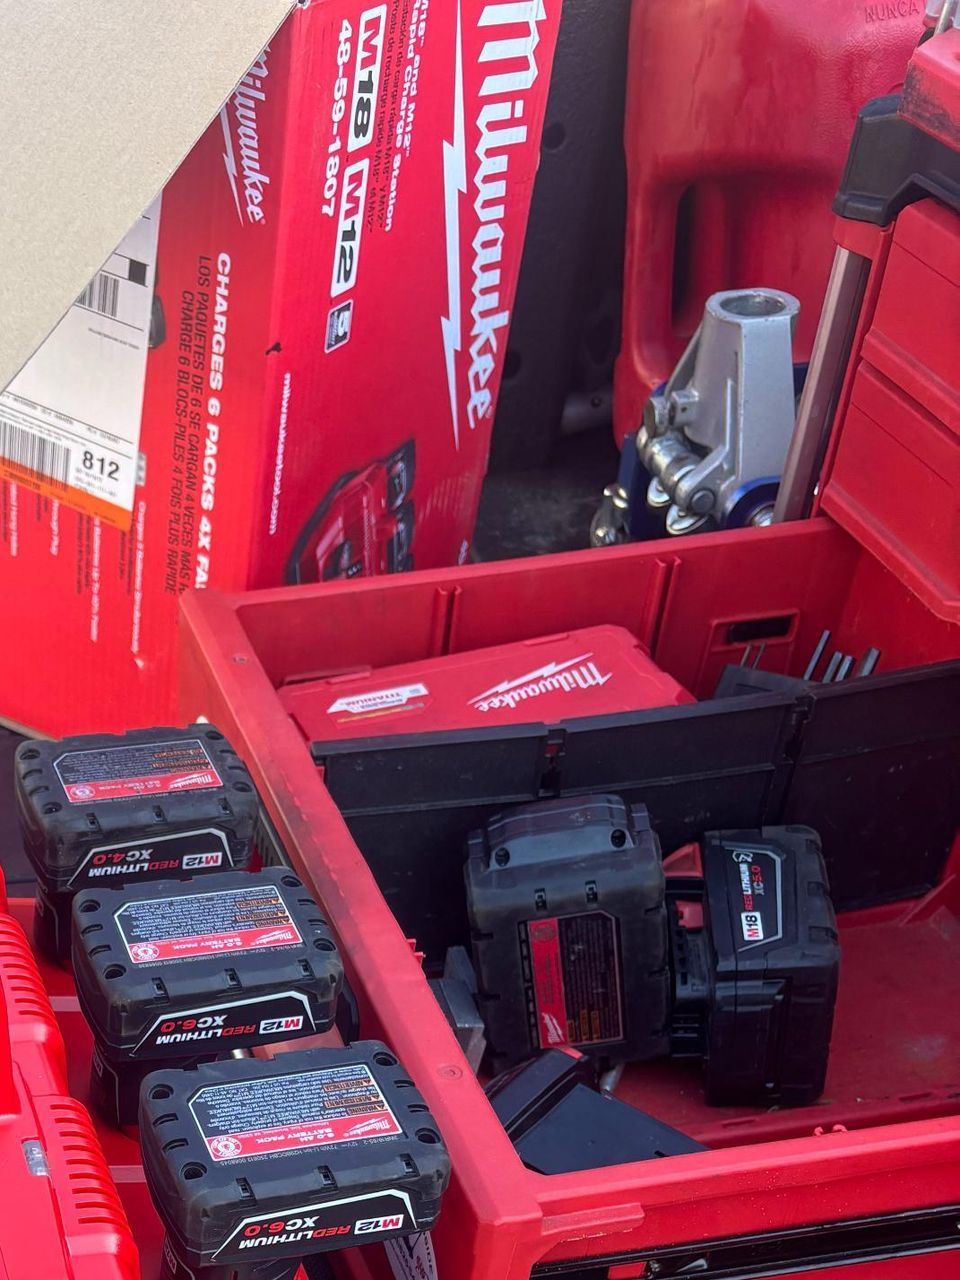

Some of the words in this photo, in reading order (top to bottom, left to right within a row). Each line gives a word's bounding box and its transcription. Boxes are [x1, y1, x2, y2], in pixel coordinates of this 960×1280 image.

[864, 0, 919, 23] NUNCA
[354, 15, 382, 139] M18
[410, 54, 420, 96] and
[321, 18, 352, 217] 48-59-1807
[396, 65, 412, 148] Charge
[385, 153, 401, 232] Station
[336, 168, 364, 284] M12
[467, 0, 547, 430] Milwaukee
[198, 255, 211, 287] LOS
[179, 290, 195, 355] CHARGE
[192, 291, 209, 371] PAQUETES
[209, 252, 231, 391] CHARGES
[178, 356, 190, 367] 6
[191, 373, 204, 395] DE
[173, 369, 190, 462] BLOCS-PILES
[190, 399, 202, 408] 6
[207, 396, 221, 417] 6
[189, 409, 201, 431] SE
[82, 449, 120, 481] 812
[172, 465, 183, 474] 4
[185, 433, 200, 492] CARGAN
[201, 423, 219, 511] PACKS
[170, 479, 183, 510] FOIS
[168, 512, 181, 547] PLUS
[180, 505, 195, 548] VECES
[198, 515, 211, 552] 4X
[165, 549, 178, 596] RAPIDE
[475, 662, 613, 712] Milwaukee
[88, 859, 180, 877] REDLITHIUM
[93, 849, 153, 865] XC4.0
[185, 853, 220, 867] M12
[739, 863, 754, 911] REDLITHIUM
[752, 865, 764, 895] XC5.0
[255, 931, 294, 944] Milwaukee
[744, 914, 759, 938] M18
[156, 1024, 256, 1045] REDLITHIUM
[161, 1014, 228, 1033] XC6.0
[264, 1018, 301, 1032] M12
[256, 1135, 285, 1144] PACK
[287, 1128, 333, 1139] BATTERY
[348, 1119, 392, 1136] Milwaukee
[239, 1224, 352, 1249] REDLITHIUM
[244, 1215, 320, 1237] XC6.0
[358, 1216, 401, 1232] M12
